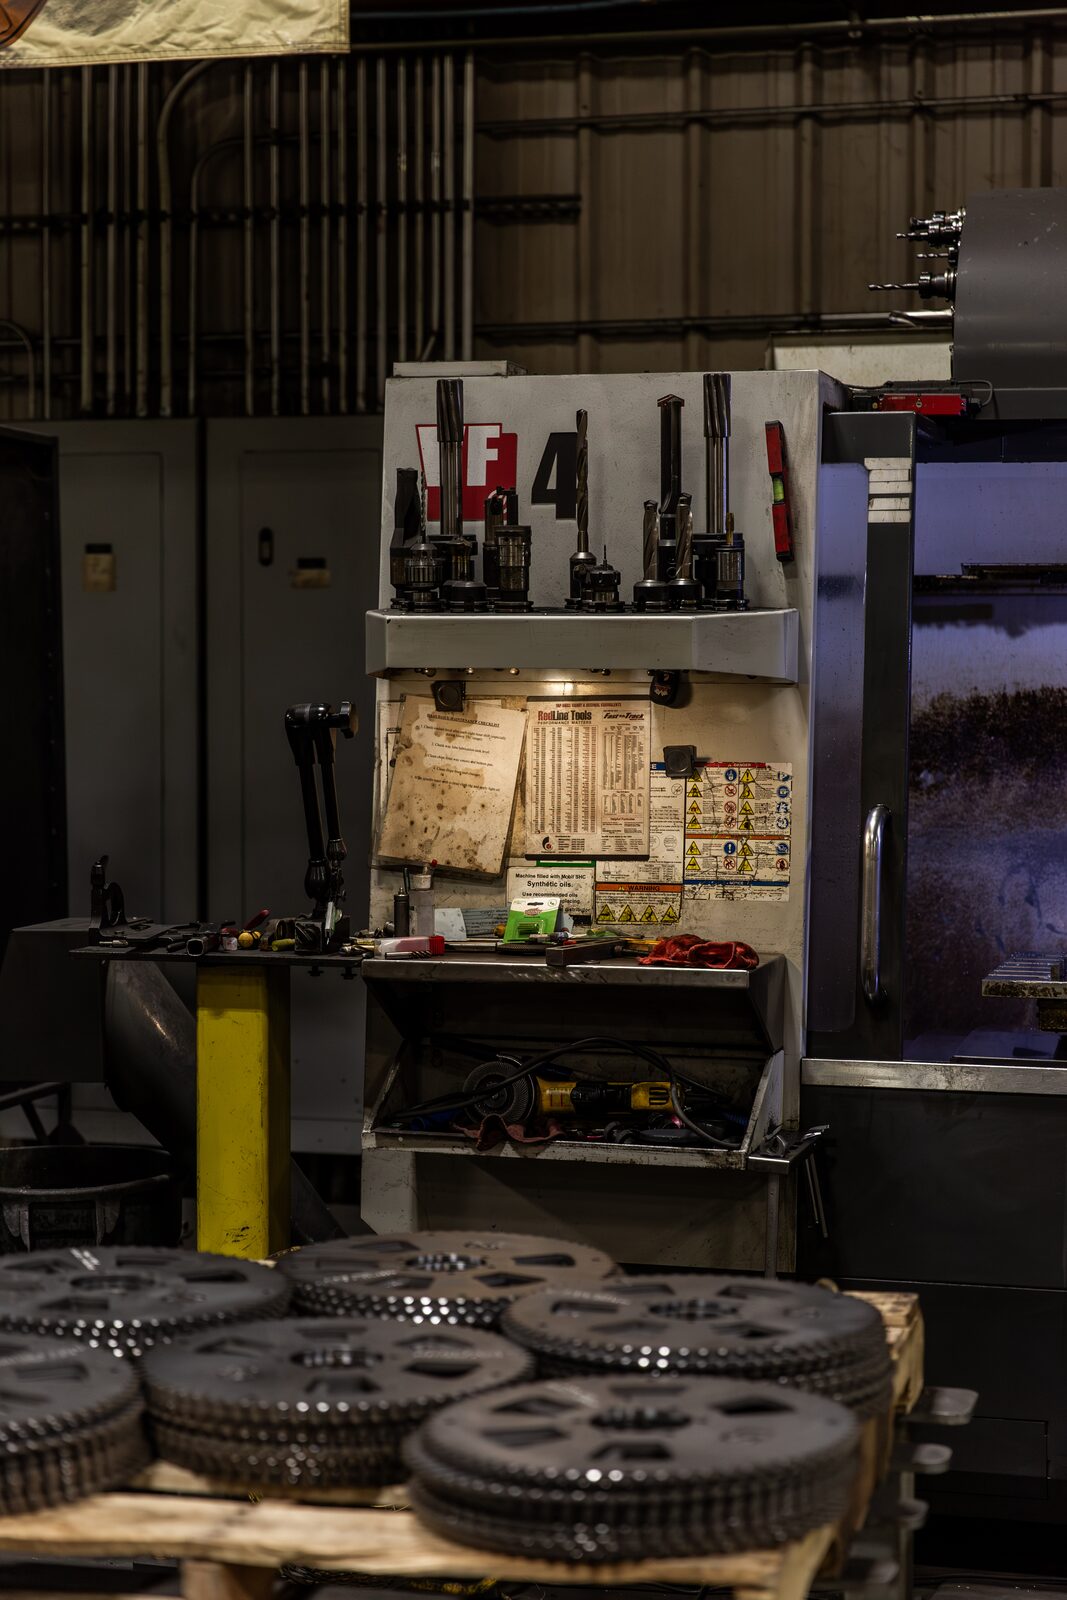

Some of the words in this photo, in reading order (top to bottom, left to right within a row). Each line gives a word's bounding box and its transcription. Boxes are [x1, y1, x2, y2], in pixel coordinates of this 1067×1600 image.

[531, 432, 577, 519] 4
[538, 710, 569, 721] RedLine
[571, 710, 592, 721] Tools
[527, 880, 558, 888] Synthetic
